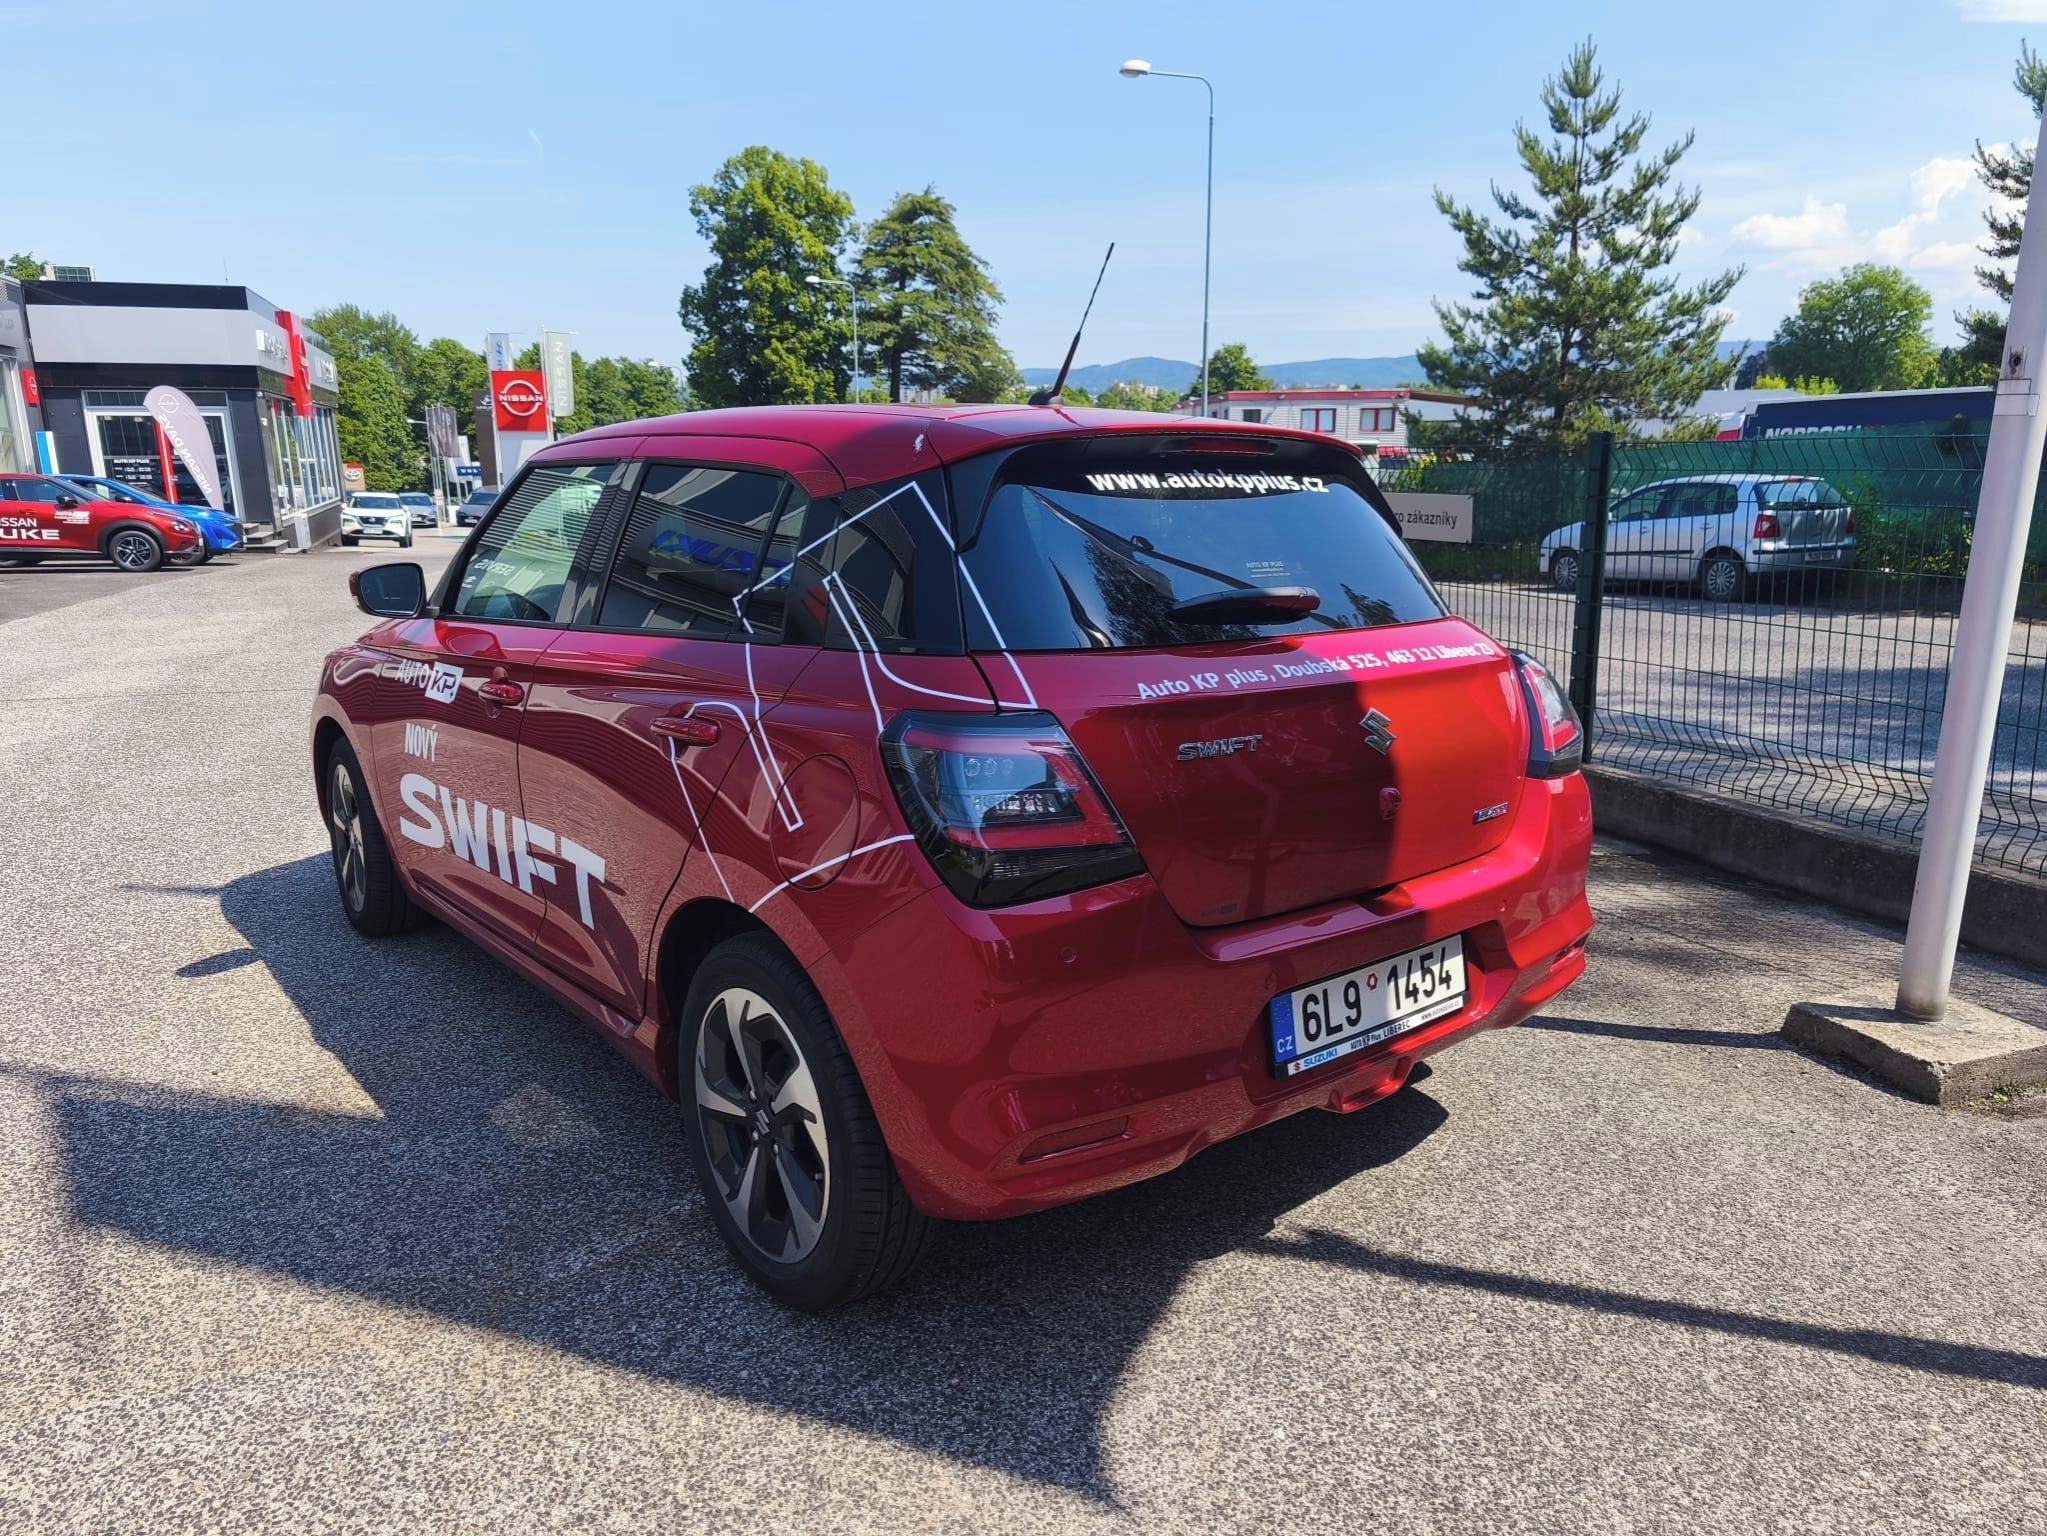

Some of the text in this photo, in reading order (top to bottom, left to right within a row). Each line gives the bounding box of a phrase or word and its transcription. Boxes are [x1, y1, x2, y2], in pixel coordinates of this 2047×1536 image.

[499, 394, 544, 402] NISSAN
[1086, 468, 1330, 494] www.autokpplus.cz
[0, 517, 37, 527] SSAN
[1407, 509, 1457, 530] zákazníky
[395, 658, 429, 688] AUTO
[1137, 679, 1190, 700] Auto
[1190, 672, 1220, 690] KP
[1225, 668, 1276, 689] plus,
[1272, 655, 1351, 679] Doubská
[1347, 652, 1389, 669] 525,
[1412, 647, 1437, 661] 12
[405, 724, 438, 762] NOVÝ
[1177, 734, 1263, 761] SWIFT
[400, 773, 606, 931] SWIFT
[1302, 946, 1452, 1042] 6L9 1454
[1276, 1035, 1294, 1054] CZ
[1303, 1048, 1339, 1068] SUZUKI
[1383, 1019, 1411, 1038] LIBEREC
